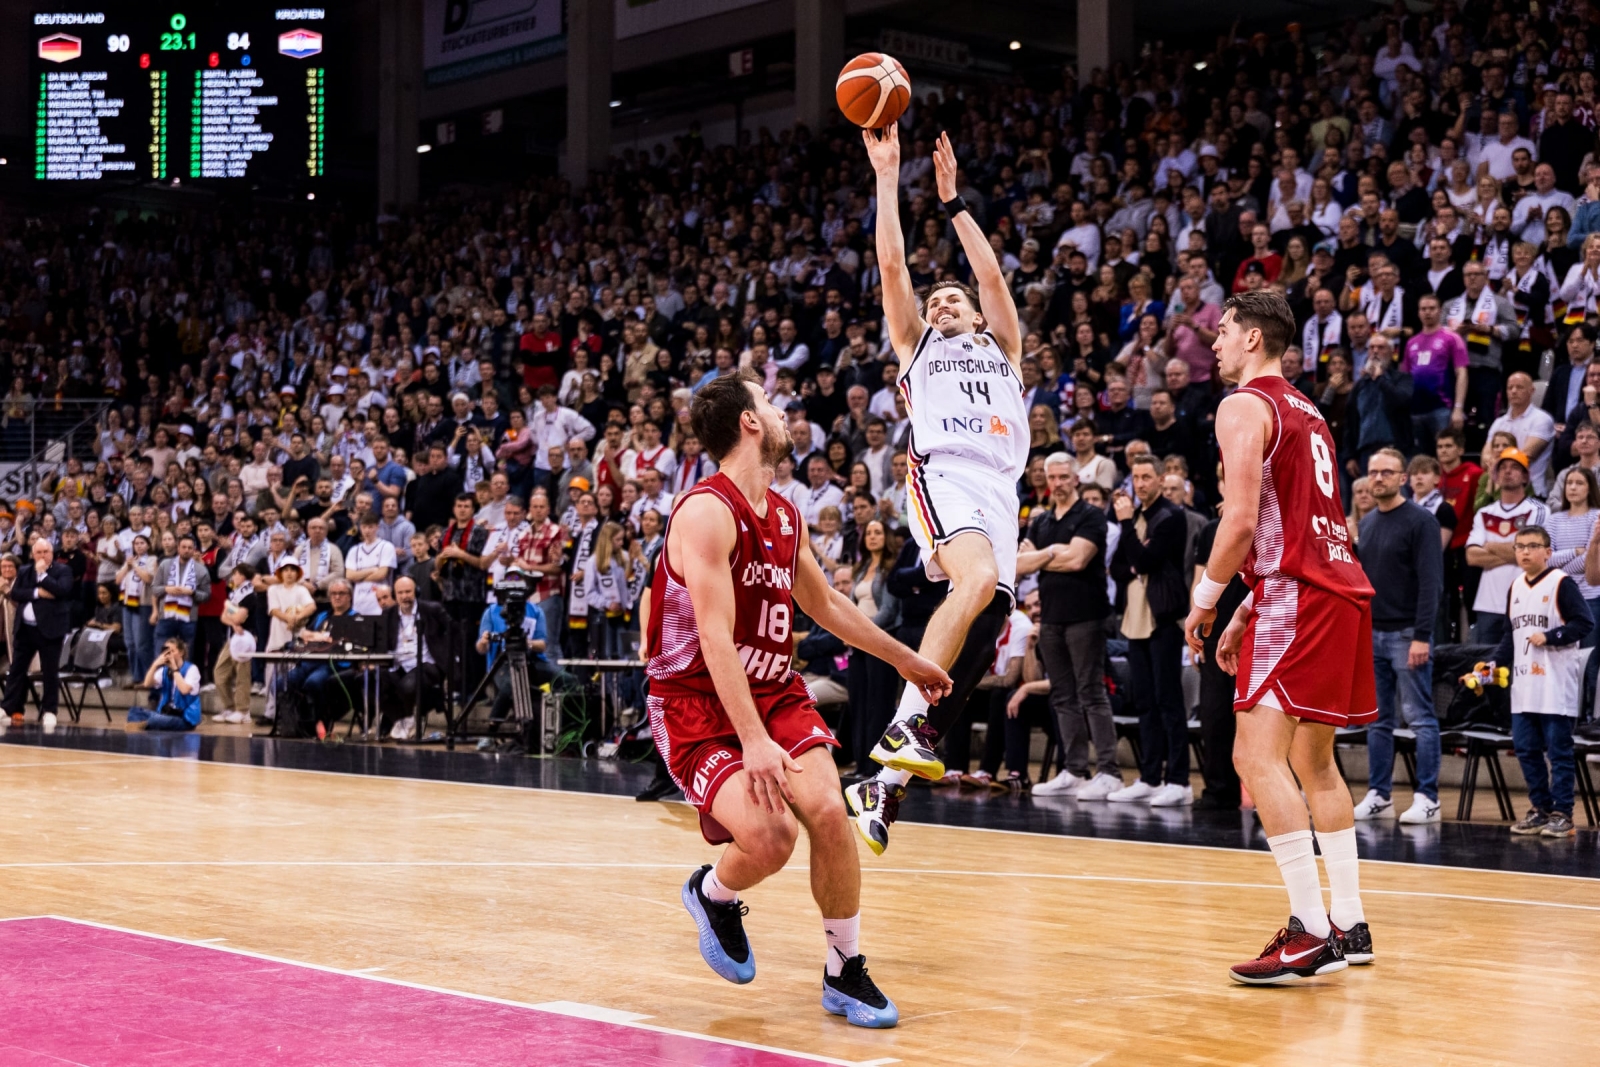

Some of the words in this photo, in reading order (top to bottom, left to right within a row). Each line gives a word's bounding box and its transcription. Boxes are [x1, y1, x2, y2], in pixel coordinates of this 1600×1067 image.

[34, 12, 104, 24] DEUTSCHLAND
[276, 9, 325, 20] KROATIEN
[107, 35, 130, 52] 90
[160, 33, 196, 50] 23.1
[227, 33, 251, 50] 84
[140, 54, 150, 68] 5
[208, 53, 220, 68] 5
[928, 358, 1009, 377] DEUTSCHLAND
[959, 381, 991, 405] 44
[941, 416, 984, 434] ING
[1310, 430, 1334, 500] 8
[758, 598, 790, 643] 18
[700, 750, 732, 776] HPB
